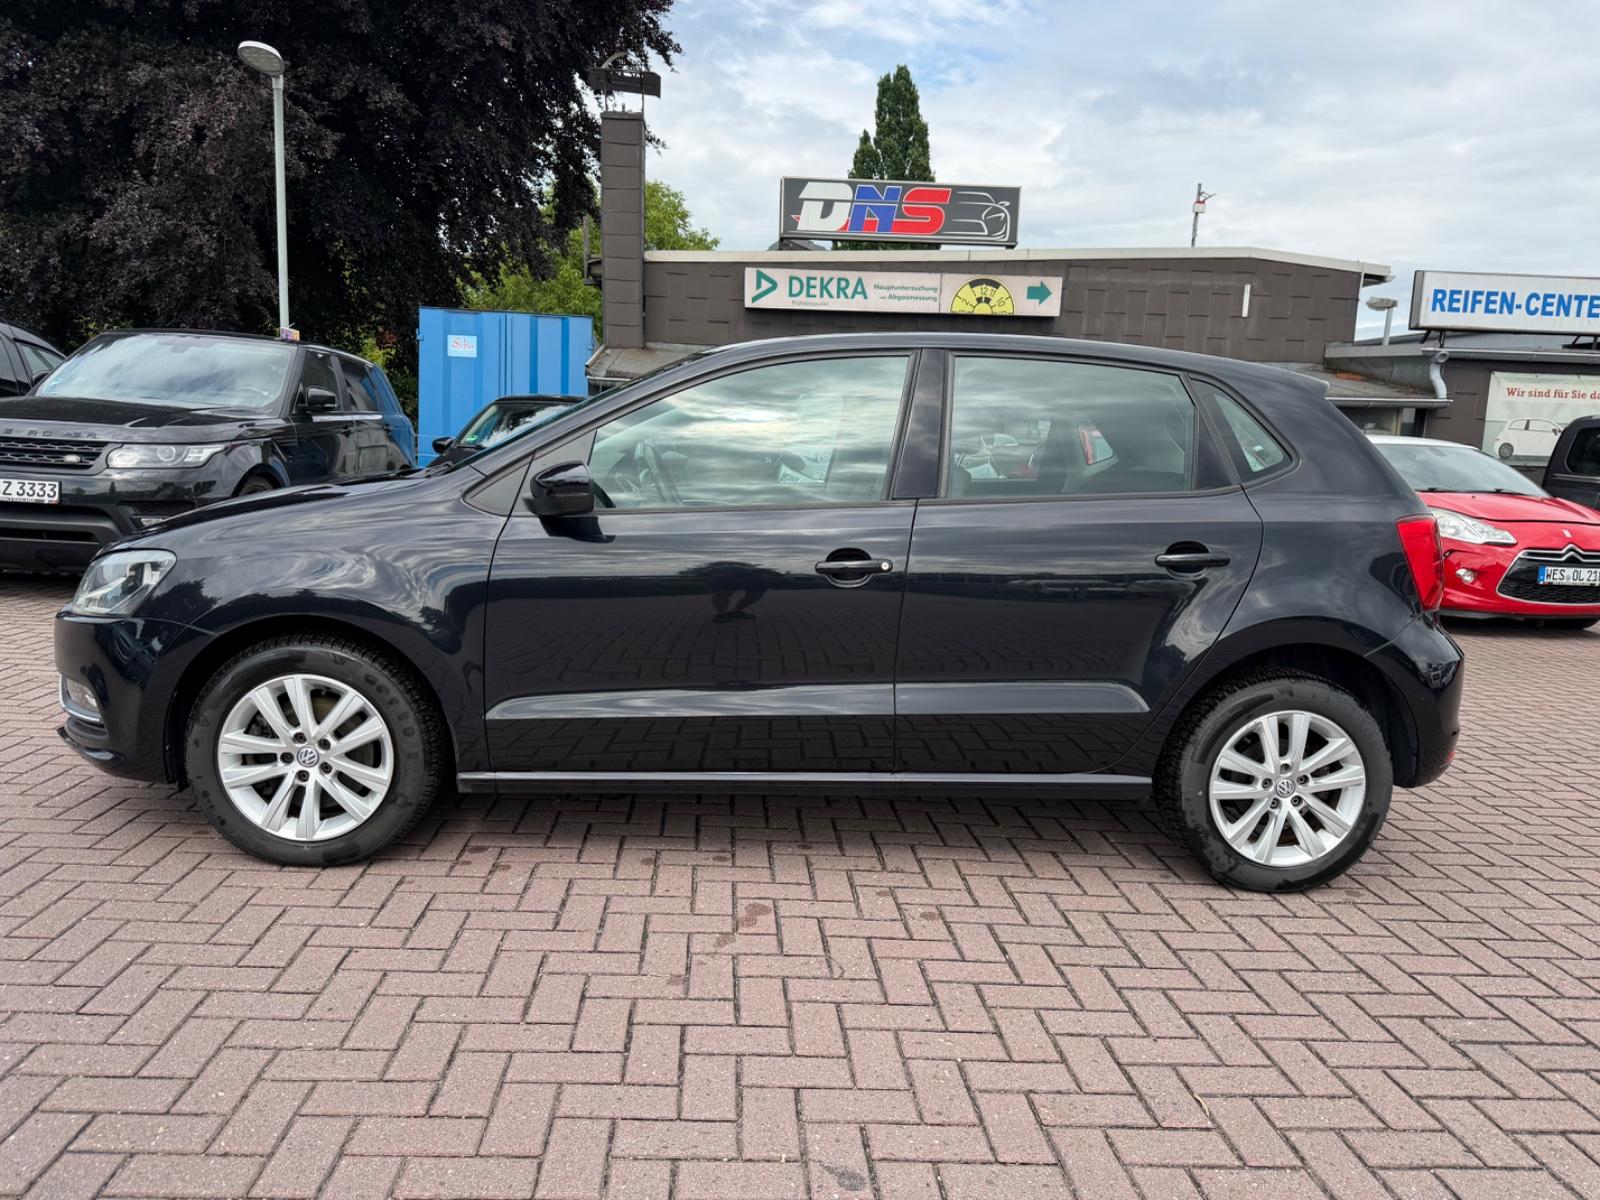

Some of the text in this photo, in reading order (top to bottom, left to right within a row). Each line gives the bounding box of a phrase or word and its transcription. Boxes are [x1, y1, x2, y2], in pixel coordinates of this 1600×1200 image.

[797, 181, 951, 235] DNS
[788, 276, 868, 300] DEKRA
[1431, 288, 1600, 318] REIFEN-CENTE
[1506, 387, 1527, 398] Wir
[1527, 387, 1551, 399] sind
[1553, 388, 1570, 399] für
[1571, 389, 1588, 400] Sie
[16, 481, 58, 499] 3333
[1545, 568, 1566, 581] WES
